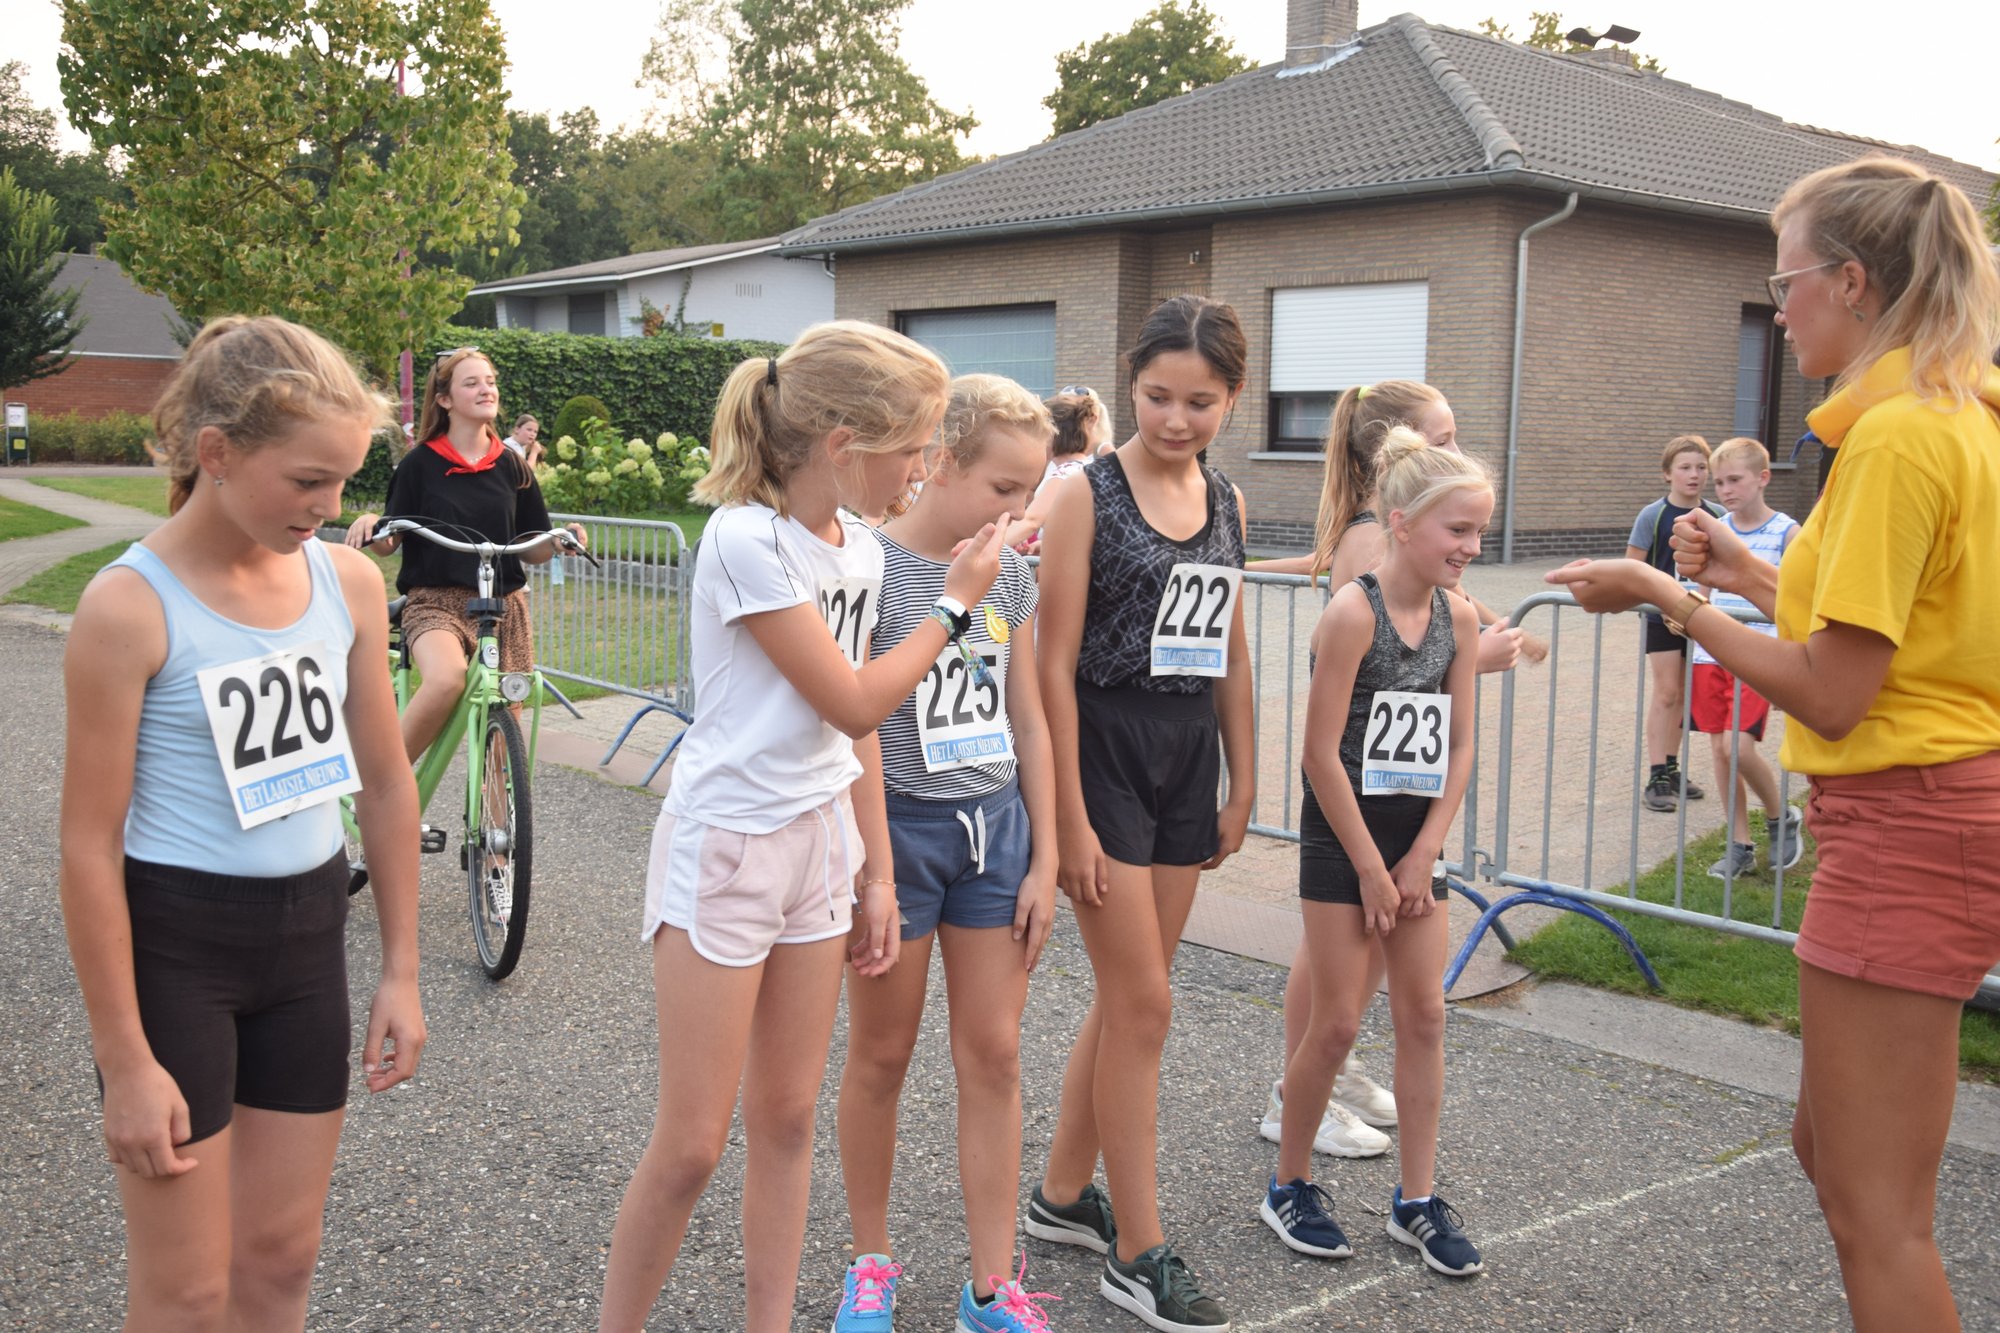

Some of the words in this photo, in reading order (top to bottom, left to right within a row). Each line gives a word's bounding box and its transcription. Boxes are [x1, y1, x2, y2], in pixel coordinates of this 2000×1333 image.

[1158, 574, 1230, 638] 222
[219, 656, 333, 770] 226
[922, 655, 998, 730] 225
[930, 744, 946, 762] HET
[946, 741, 977, 759] LAATSTE
[976, 736, 1003, 754] NIEUWS
[1368, 702, 1442, 764] 223
[241, 787, 264, 810] HET
[261, 773, 305, 803] LAATSTE
[304, 761, 345, 789] NIEUWS
[1367, 772, 1380, 786] HET
[1380, 772, 1410, 788] LAATSTE
[1410, 774, 1438, 789] NIEUWS
